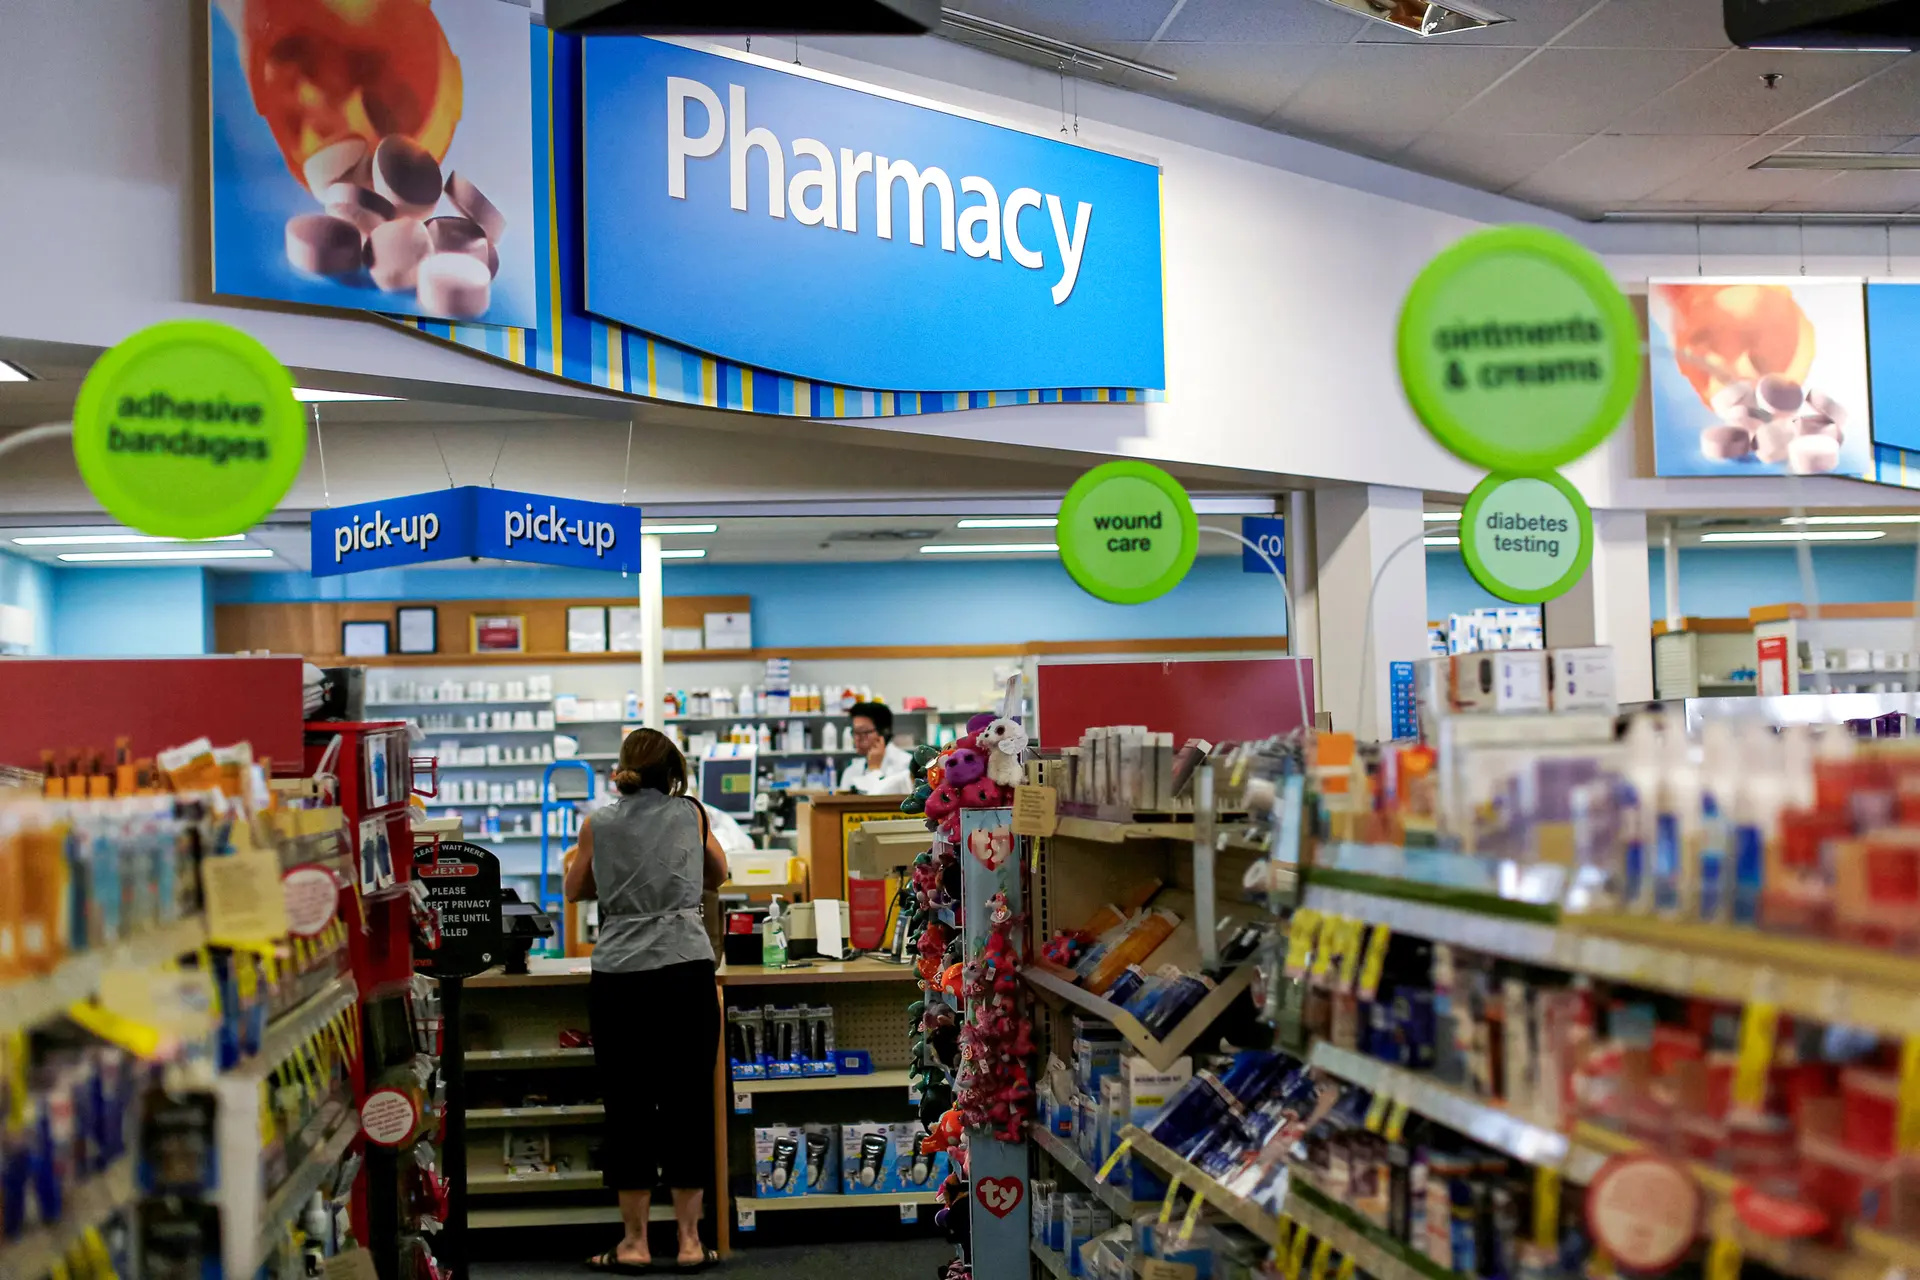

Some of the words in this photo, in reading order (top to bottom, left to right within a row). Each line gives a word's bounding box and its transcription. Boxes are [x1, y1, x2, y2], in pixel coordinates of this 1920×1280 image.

[666, 75, 1093, 306] Pharmacy
[1435, 314, 1603, 349] ointments
[1445, 360, 1468, 388] &
[1478, 358, 1603, 387] creams
[118, 391, 266, 424] adhesive
[107, 429, 270, 465] bandages
[503, 503, 617, 557] pick-up
[1094, 511, 1163, 530] wound
[1486, 511, 1569, 532] diabetes
[334, 511, 440, 562] pick-up
[1107, 535, 1152, 552] care
[1258, 534, 1285, 557] co
[1494, 535, 1560, 557] testing
[463, 845, 486, 859] HERE
[431, 886, 467, 896] PLEASE
[451, 899, 491, 909] PRIVACY
[442, 914, 460, 923] ERE
[462, 913, 491, 922] UNTIL
[440, 928, 468, 937] ALLED
[979, 1179, 1019, 1211] ty
